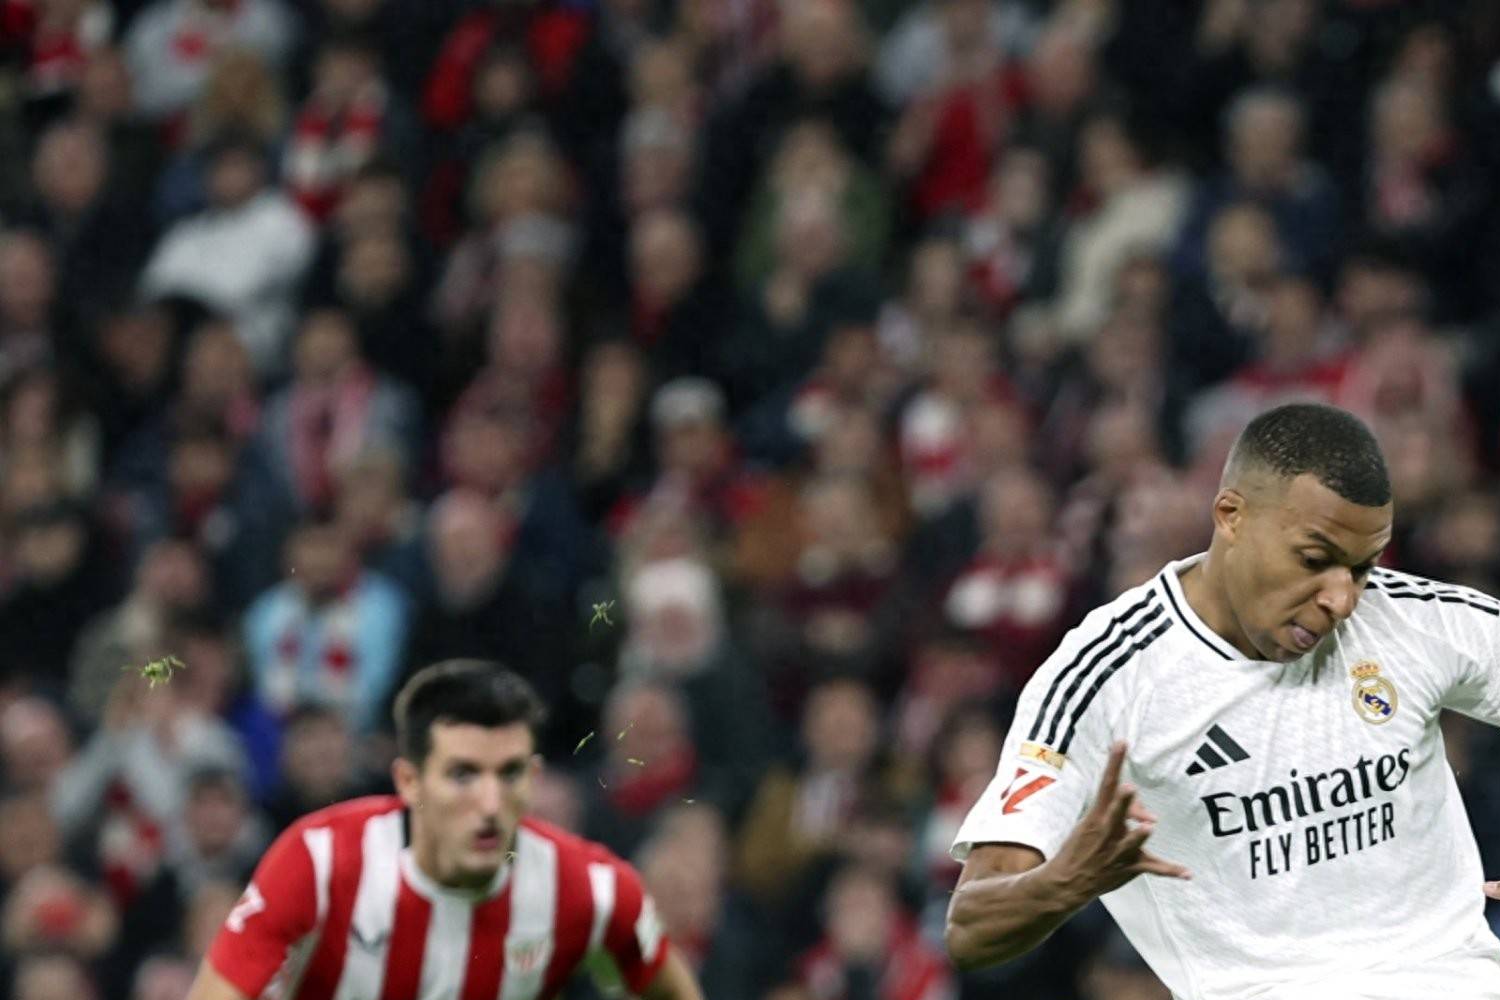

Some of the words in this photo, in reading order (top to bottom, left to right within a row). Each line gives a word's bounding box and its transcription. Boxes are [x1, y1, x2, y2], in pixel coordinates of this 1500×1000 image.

[1201, 748, 1410, 837] Emirates
[1250, 832, 1292, 879] FLY
[1305, 802, 1395, 865] BETTER
